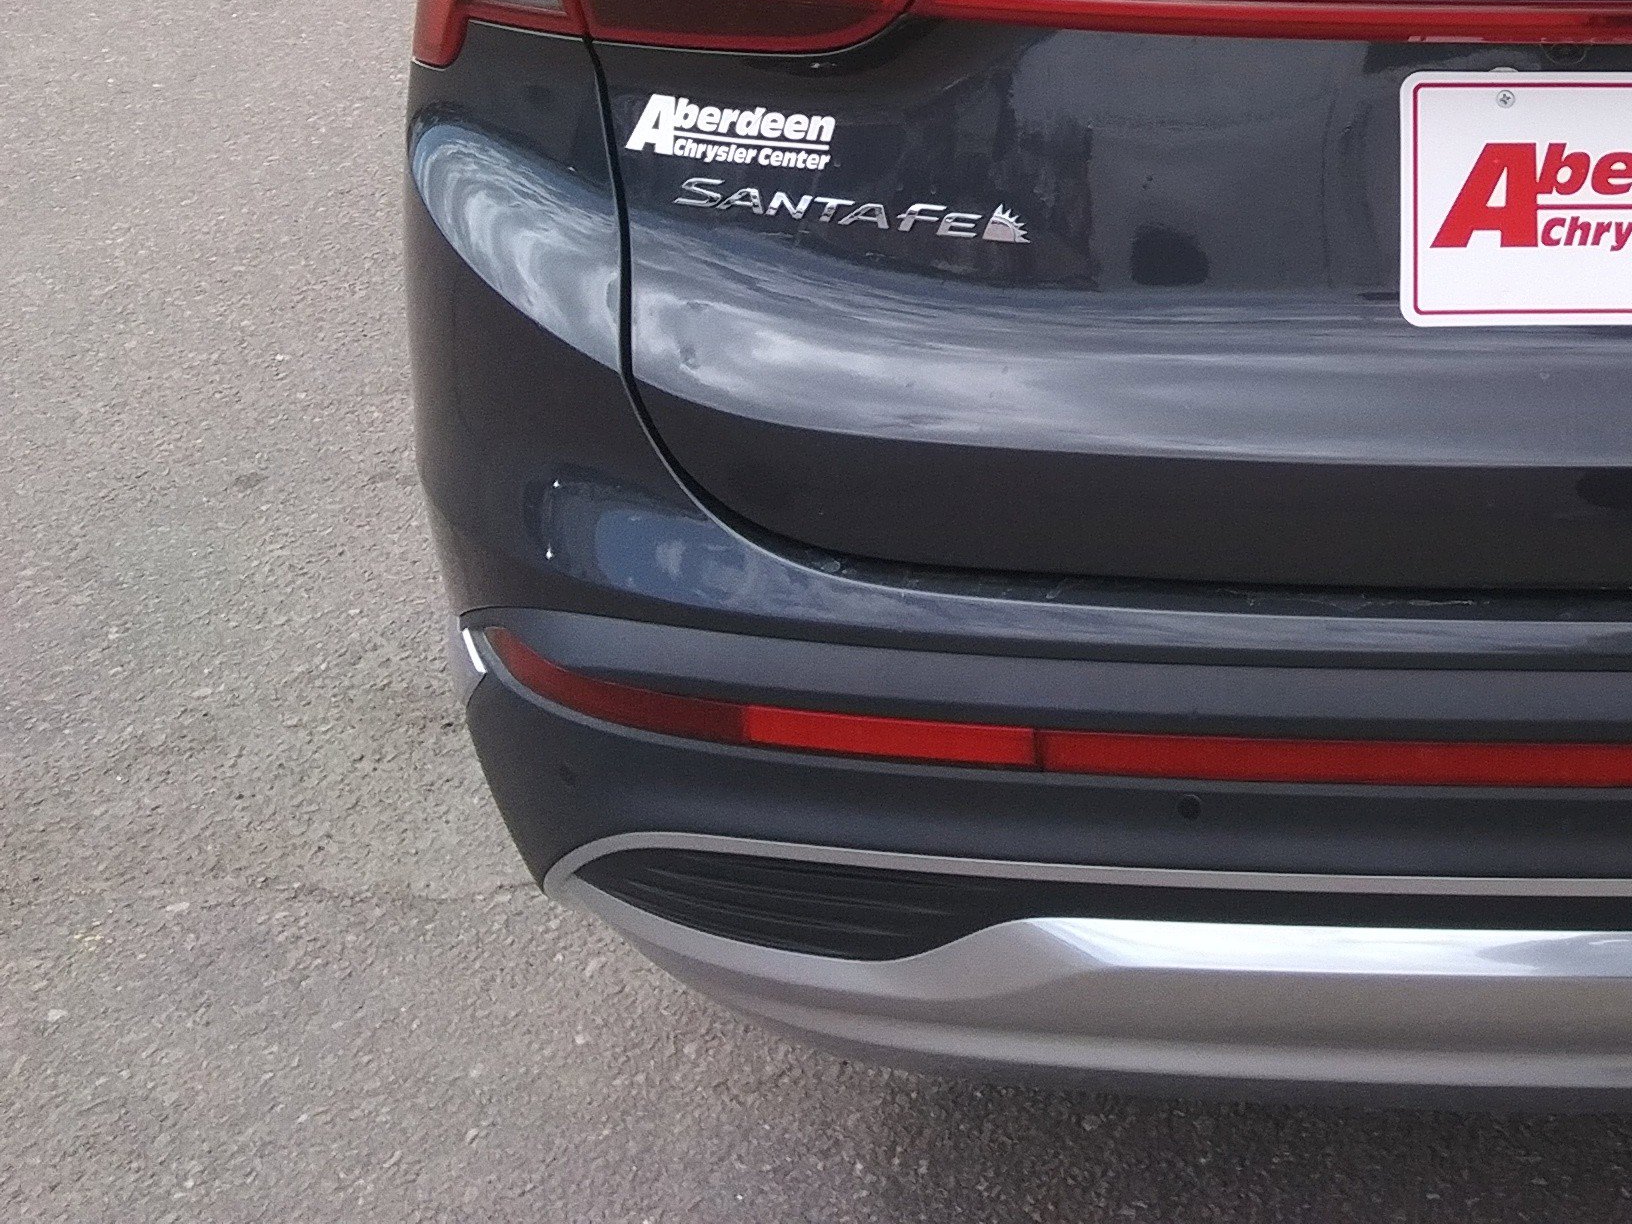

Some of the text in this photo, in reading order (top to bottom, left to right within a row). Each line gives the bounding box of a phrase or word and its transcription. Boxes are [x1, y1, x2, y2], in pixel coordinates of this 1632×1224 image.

[625, 93, 836, 156] Aberdeen
[673, 138, 831, 171] Chrysler Center
